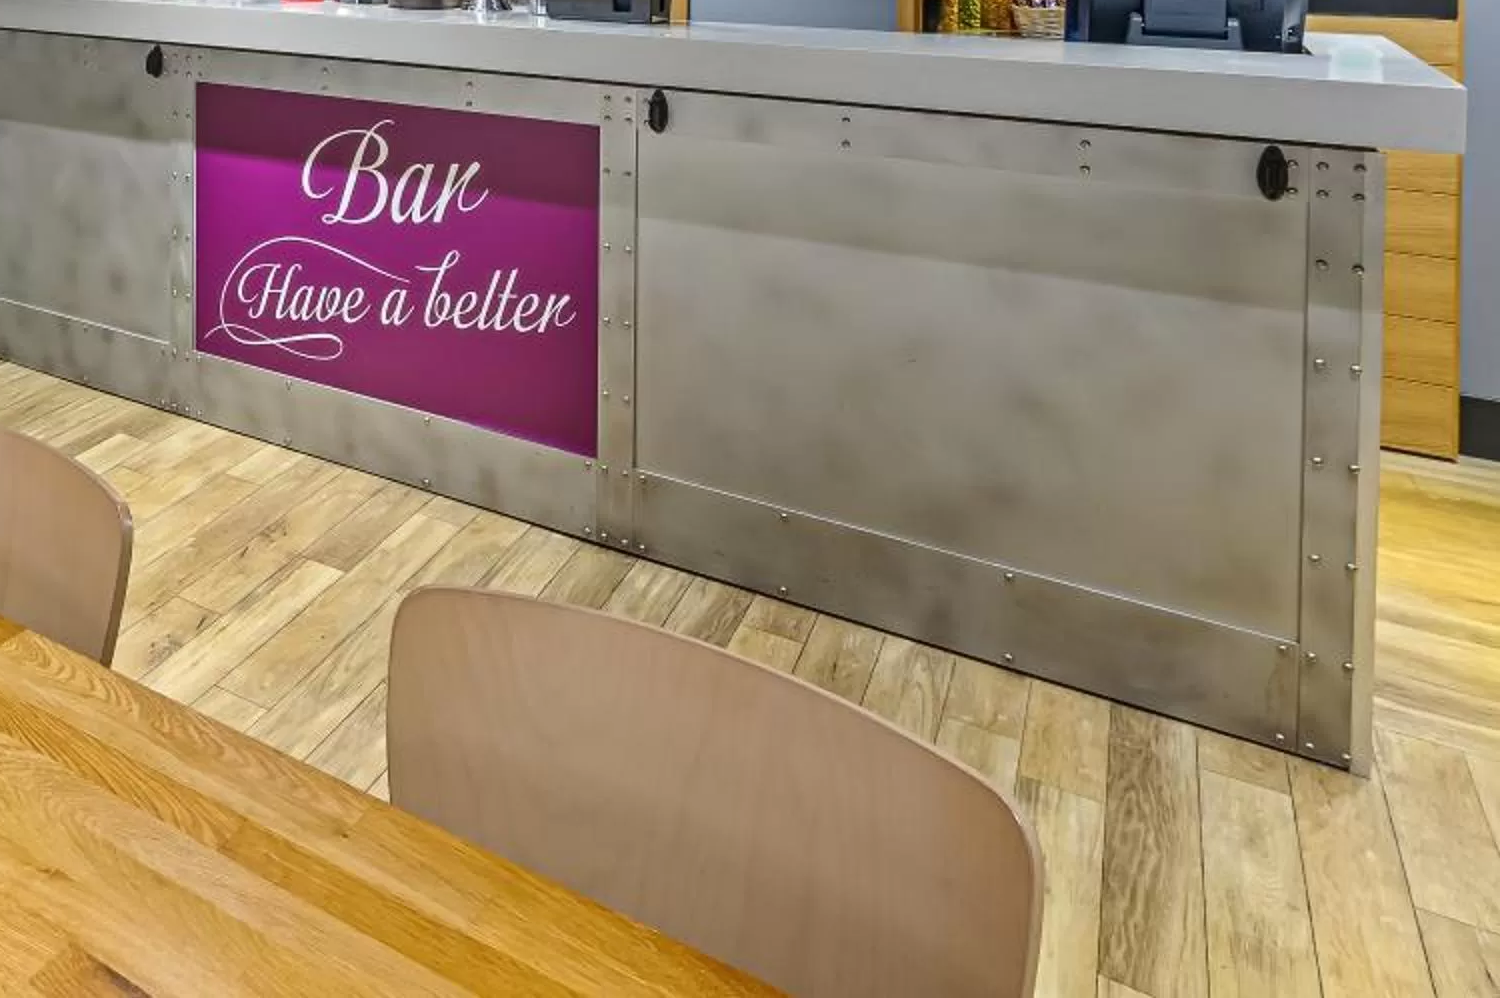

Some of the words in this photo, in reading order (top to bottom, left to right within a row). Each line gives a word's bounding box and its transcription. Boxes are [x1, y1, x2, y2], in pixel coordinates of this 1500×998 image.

[300, 119, 489, 226] Bar
[236, 262, 369, 325] Have
[380, 282, 416, 326] a
[415, 249, 576, 334] belter
